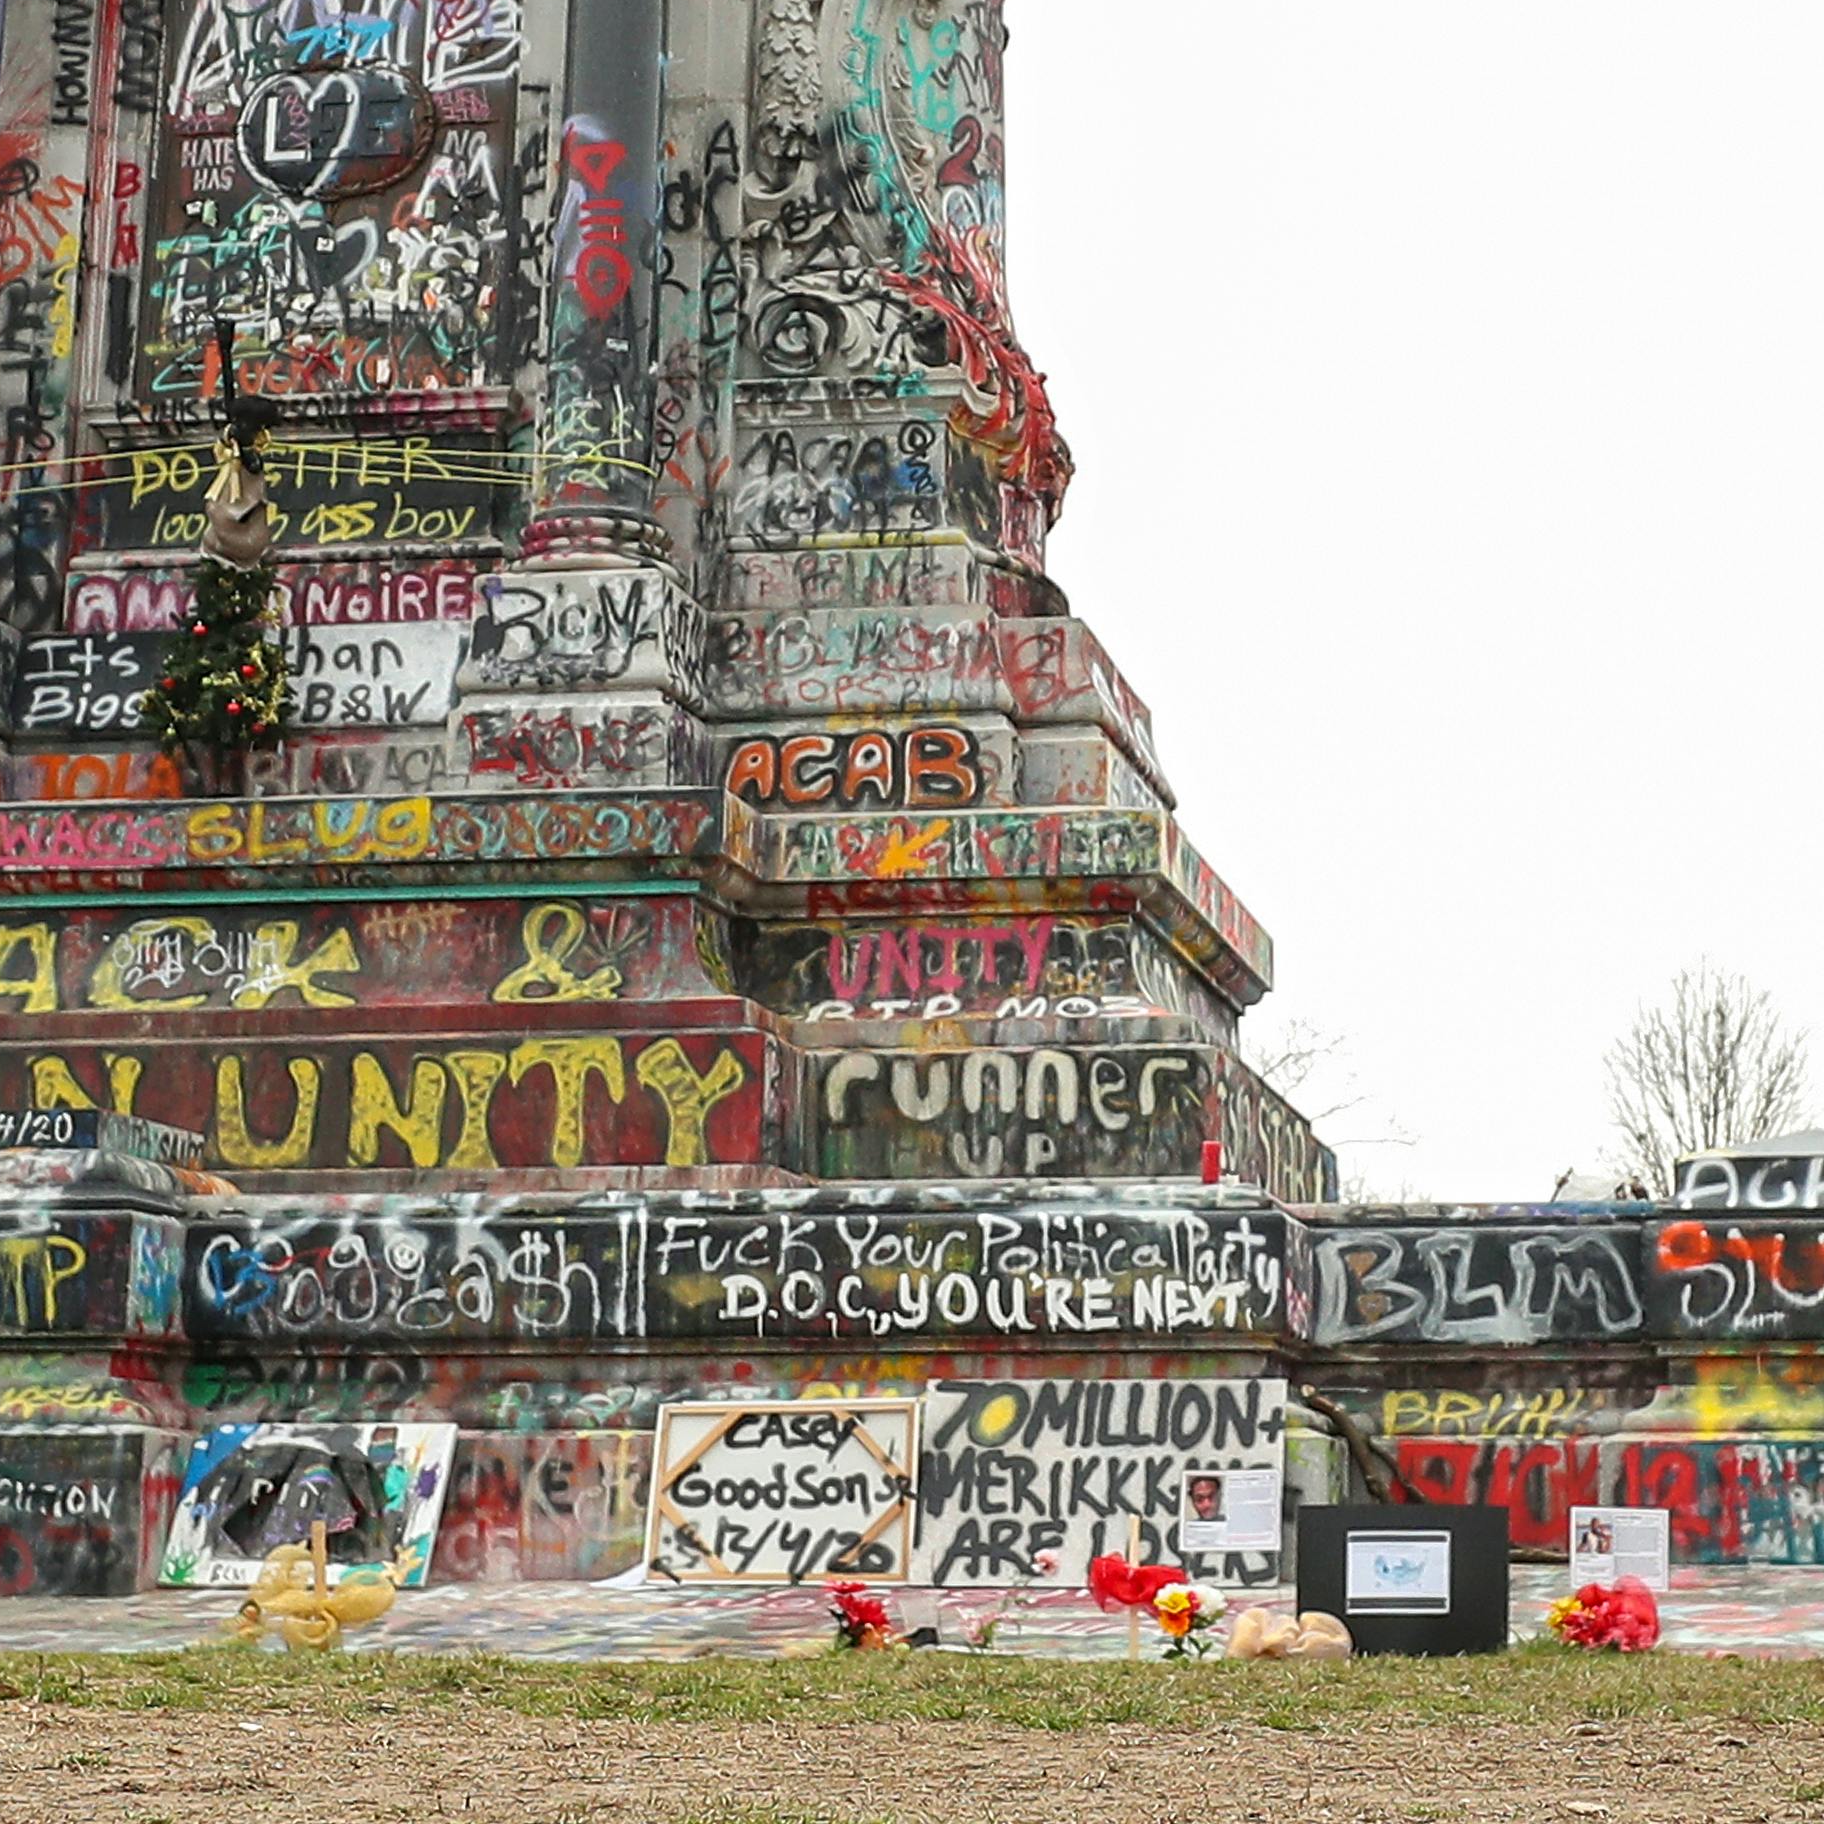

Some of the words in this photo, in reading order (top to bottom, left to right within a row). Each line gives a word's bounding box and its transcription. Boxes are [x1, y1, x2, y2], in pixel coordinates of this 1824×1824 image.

[180, 138, 234, 168] HATE
[192, 167, 234, 192] HAS
[23, 633, 141, 679] It's
[23, 683, 148, 730] Bigg
[725, 726, 978, 808] ACAB
[491, 902, 623, 1002] &
[827, 916, 1059, 1000] UNITY
[217, 1035, 746, 1171] UNITY
[826, 1049, 1188, 1131] runner
[835, 1215, 968, 1273] Your
[976, 1211, 1181, 1279] Political
[1184, 1214, 1280, 1319] Party
[1314, 1226, 1645, 1348] BLM
